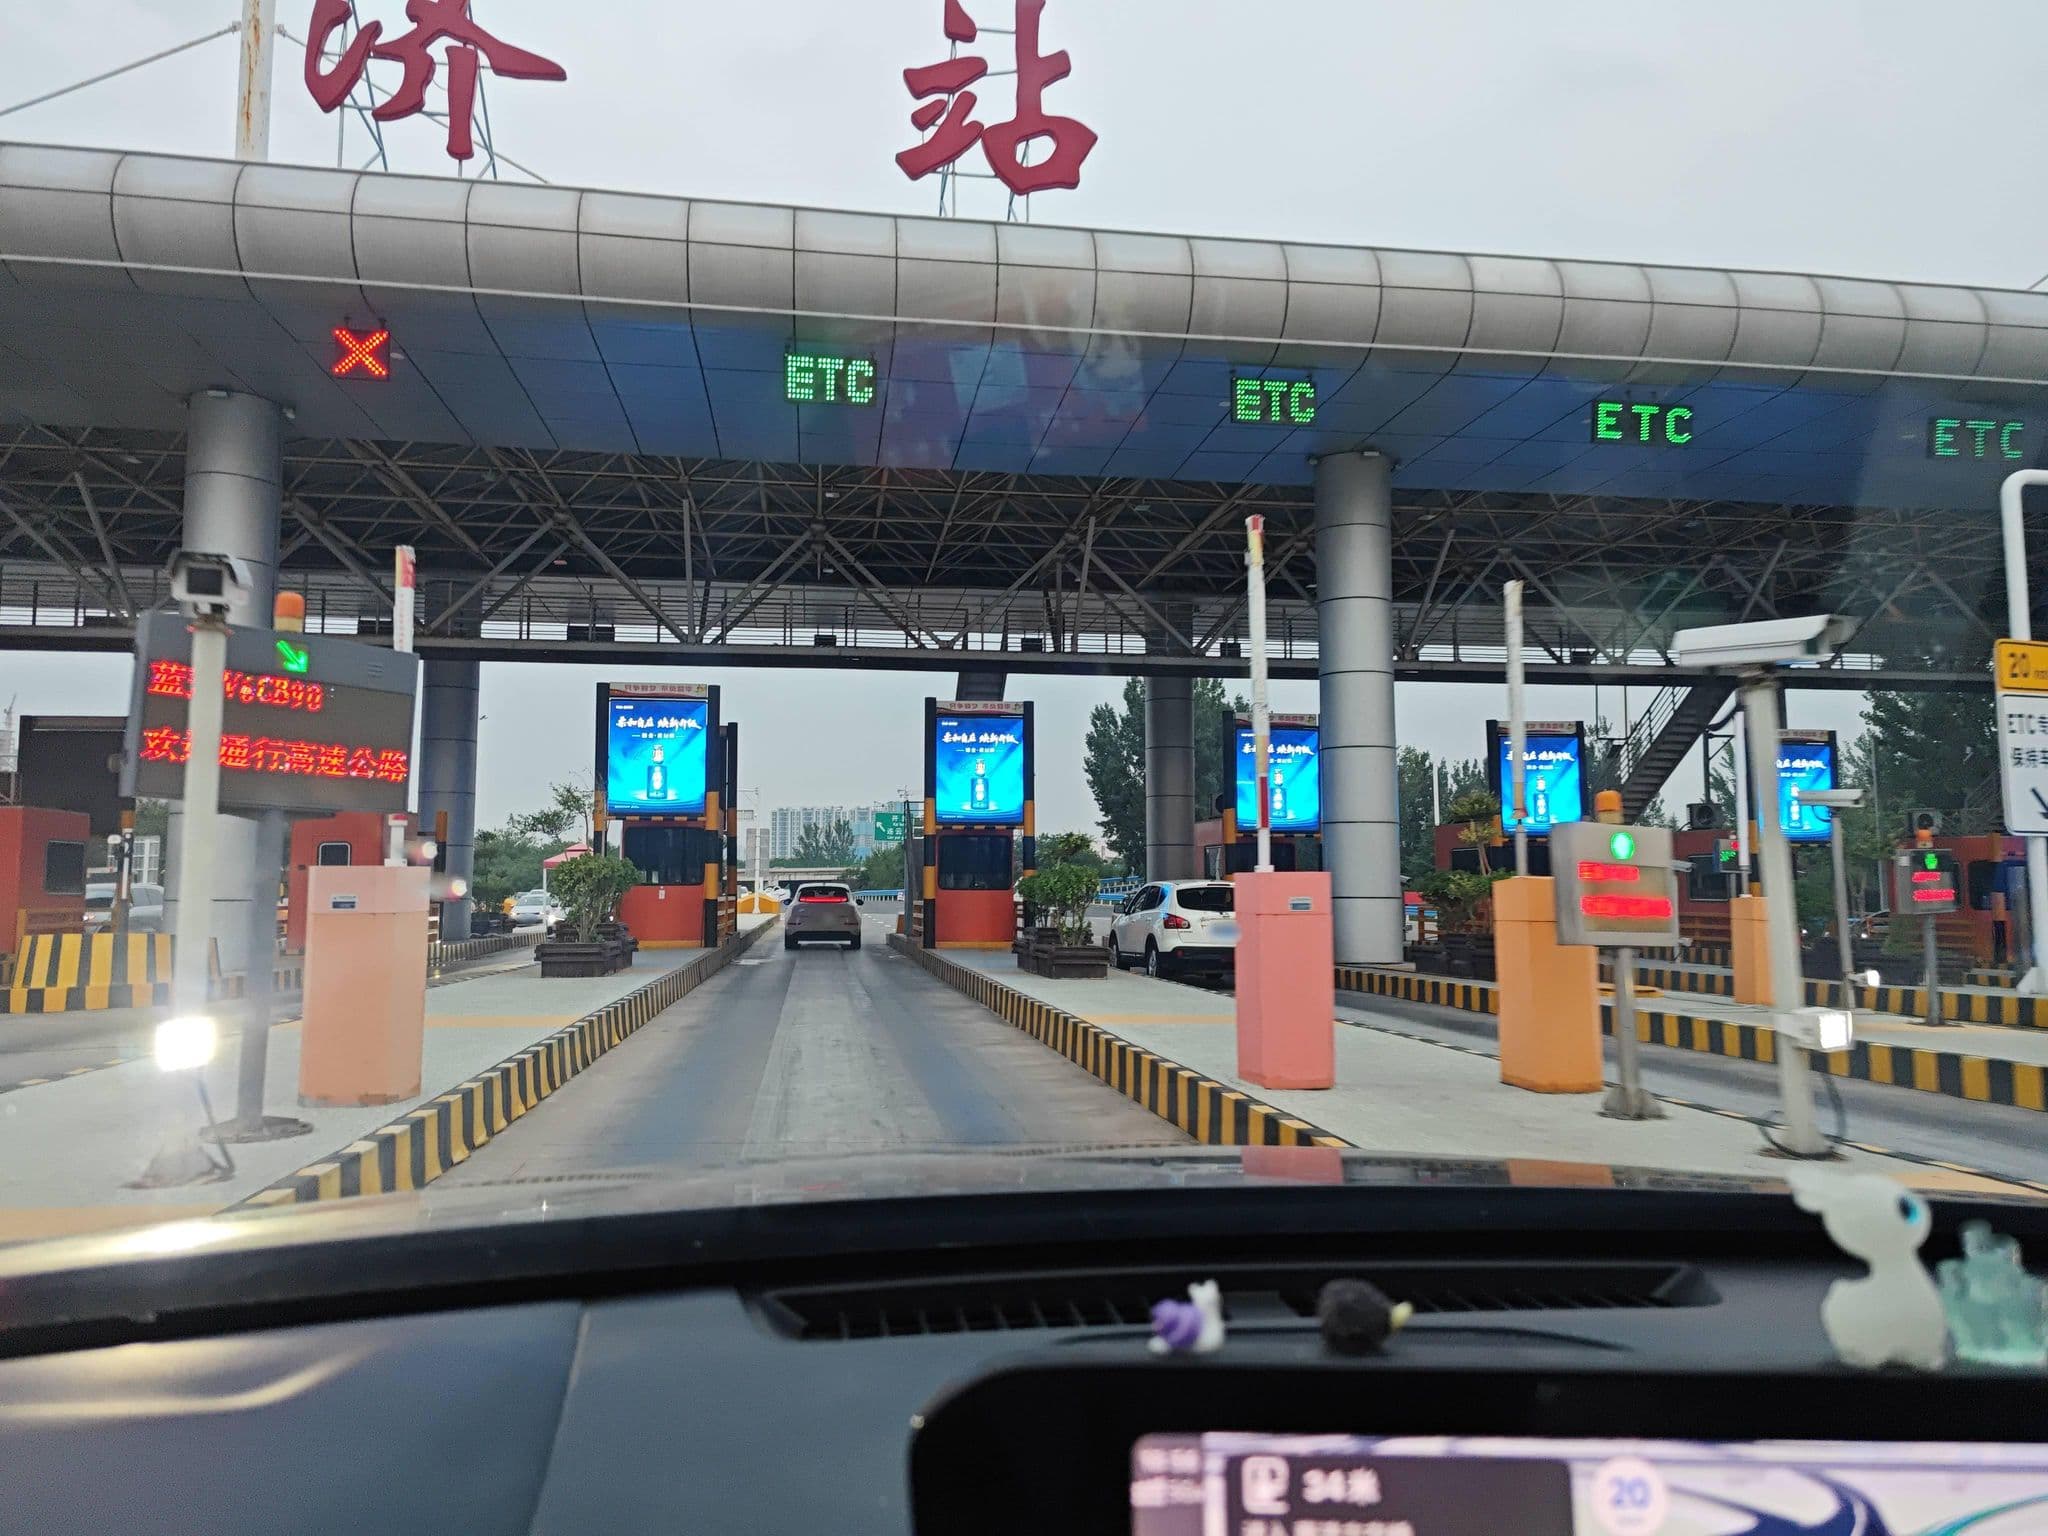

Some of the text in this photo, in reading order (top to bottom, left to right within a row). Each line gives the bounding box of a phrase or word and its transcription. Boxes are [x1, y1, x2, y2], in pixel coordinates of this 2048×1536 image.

[786, 354, 873, 403] ETC
[1236, 378, 1316, 424] ETC
[1597, 402, 1693, 444] ETC
[1935, 419, 2025, 459] ETC
[148, 659, 323, 712] 蓝V6CB90
[2008, 652, 2031, 679] 20
[139, 725, 409, 783] 欢通行高速公路
[1608, 1476, 1650, 1510] 20
